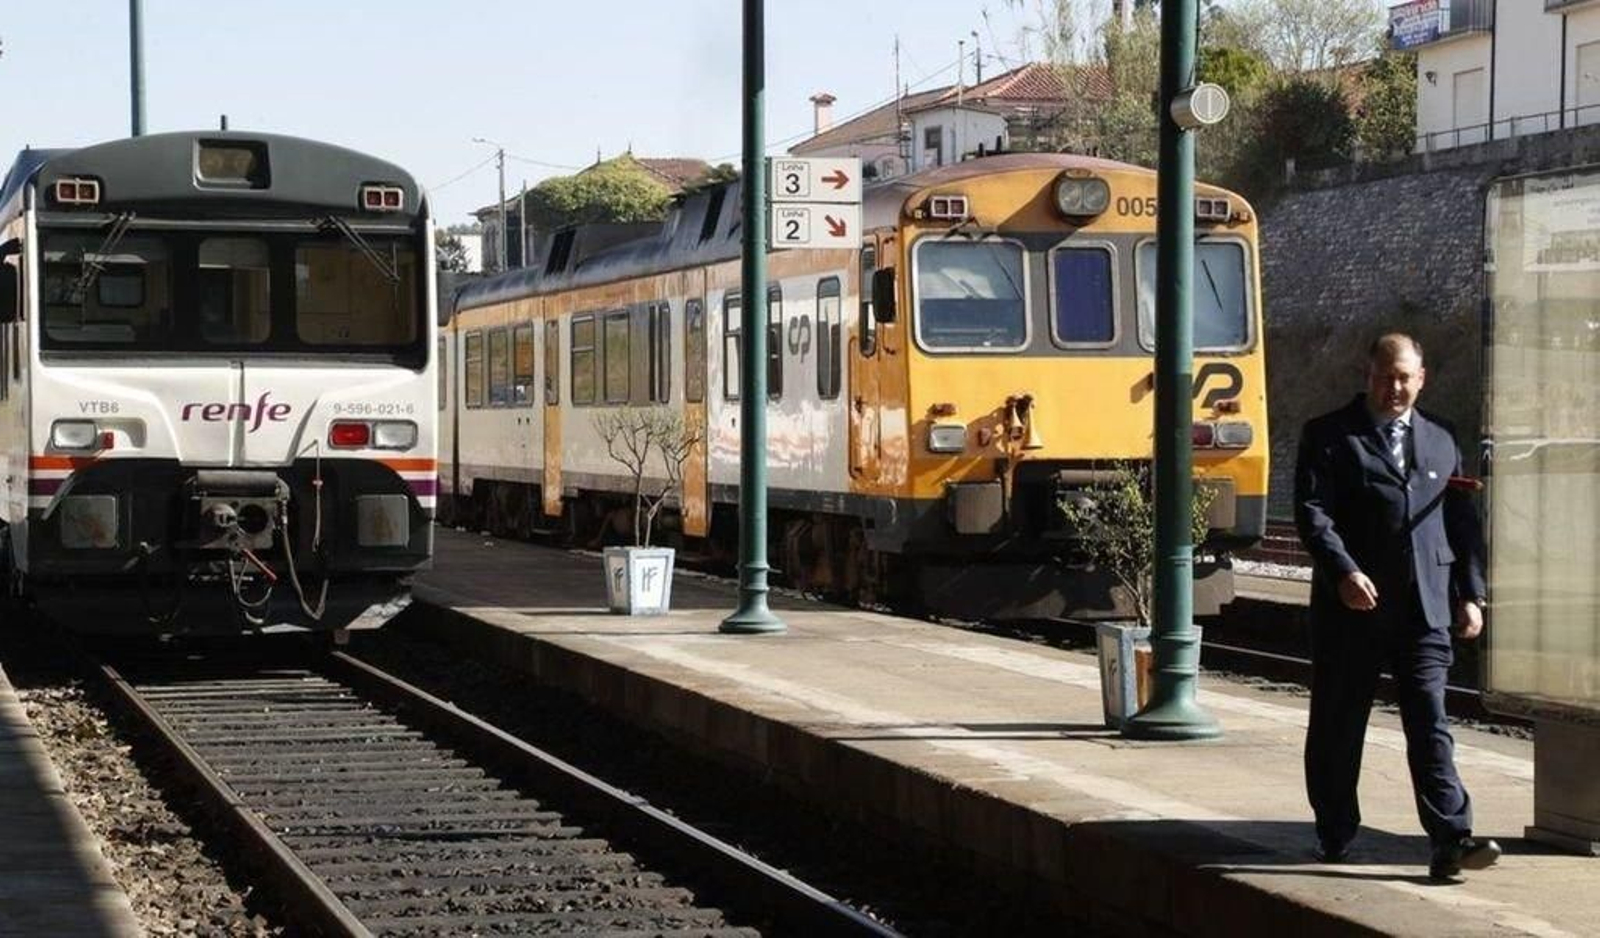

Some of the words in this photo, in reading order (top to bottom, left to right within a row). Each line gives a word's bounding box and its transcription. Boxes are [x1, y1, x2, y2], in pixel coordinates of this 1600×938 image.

[785, 173, 800, 194] 3
[1116, 196, 1158, 217] 005
[786, 219, 800, 240] 2
[181, 392, 291, 433] renfe
